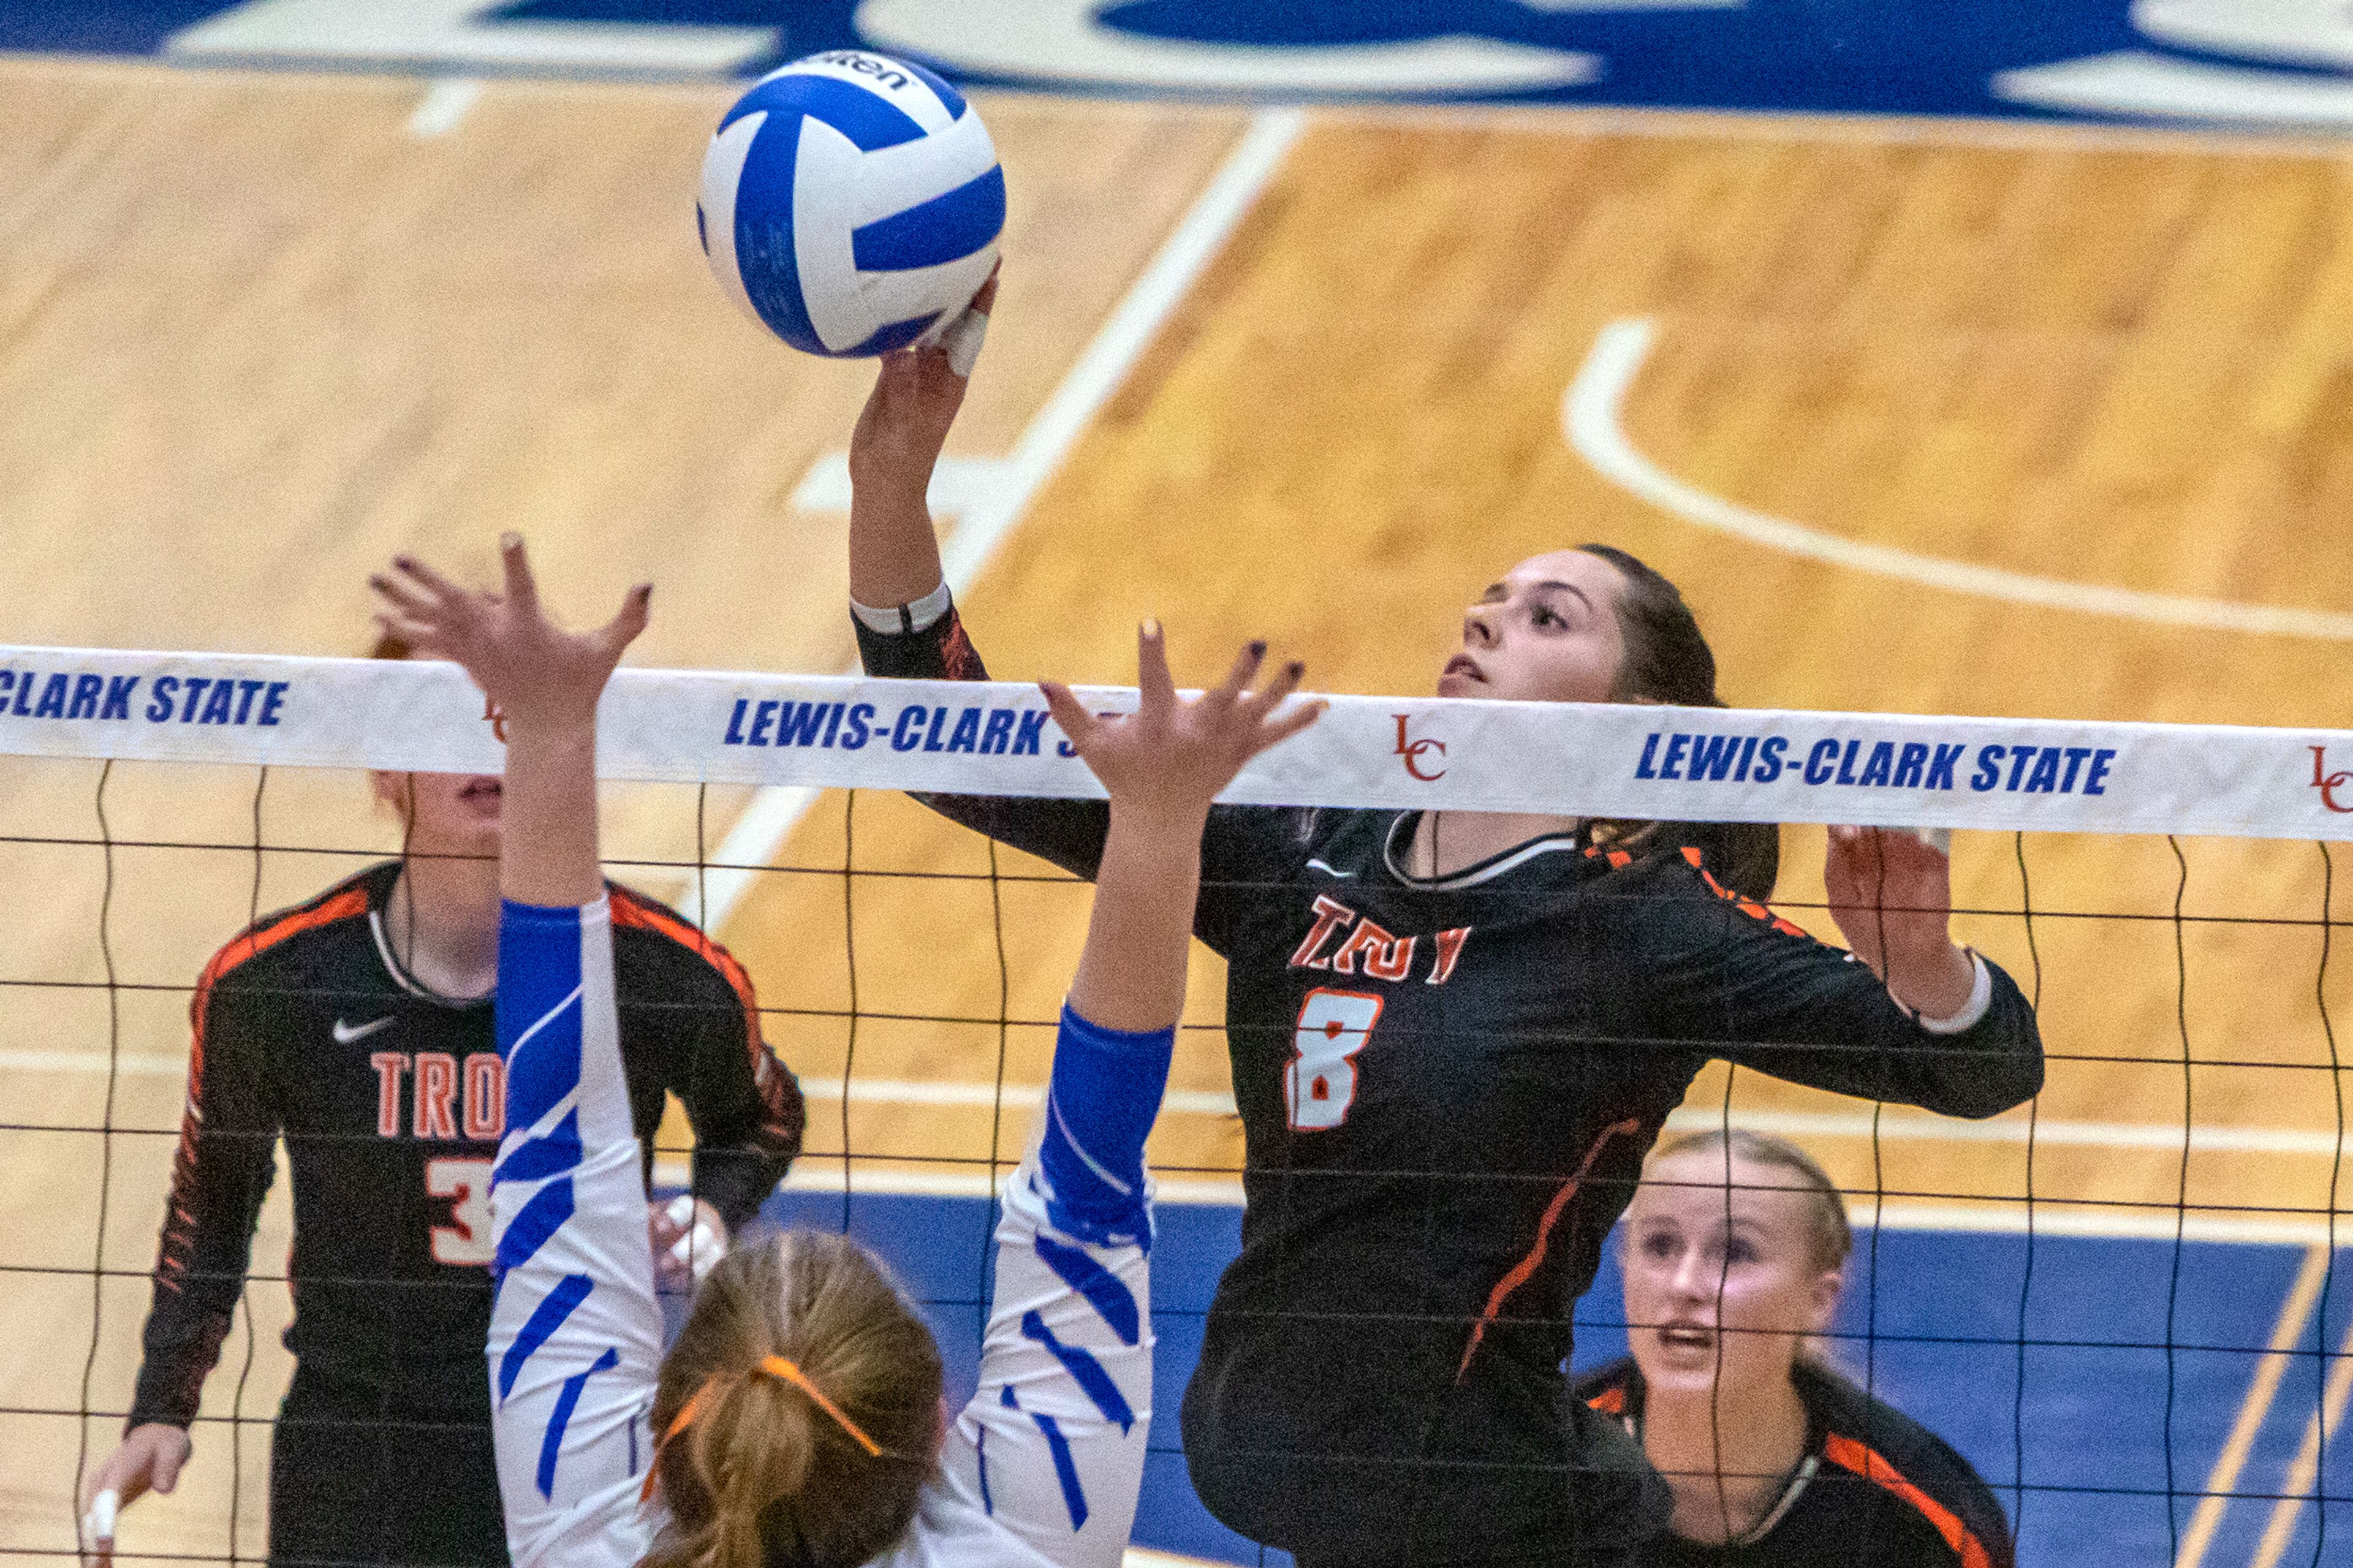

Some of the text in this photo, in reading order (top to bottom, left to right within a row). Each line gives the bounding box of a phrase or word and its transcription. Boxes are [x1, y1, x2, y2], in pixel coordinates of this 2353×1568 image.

[146, 675, 289, 726] STATE
[724, 699, 1050, 756] LEWIS-CLARK
[1634, 732, 2116, 796] LEWIS-CLARK STATE
[370, 1051, 508, 1140] TRO
[1283, 986, 1385, 1132] 8
[425, 1156, 496, 1266] 3
